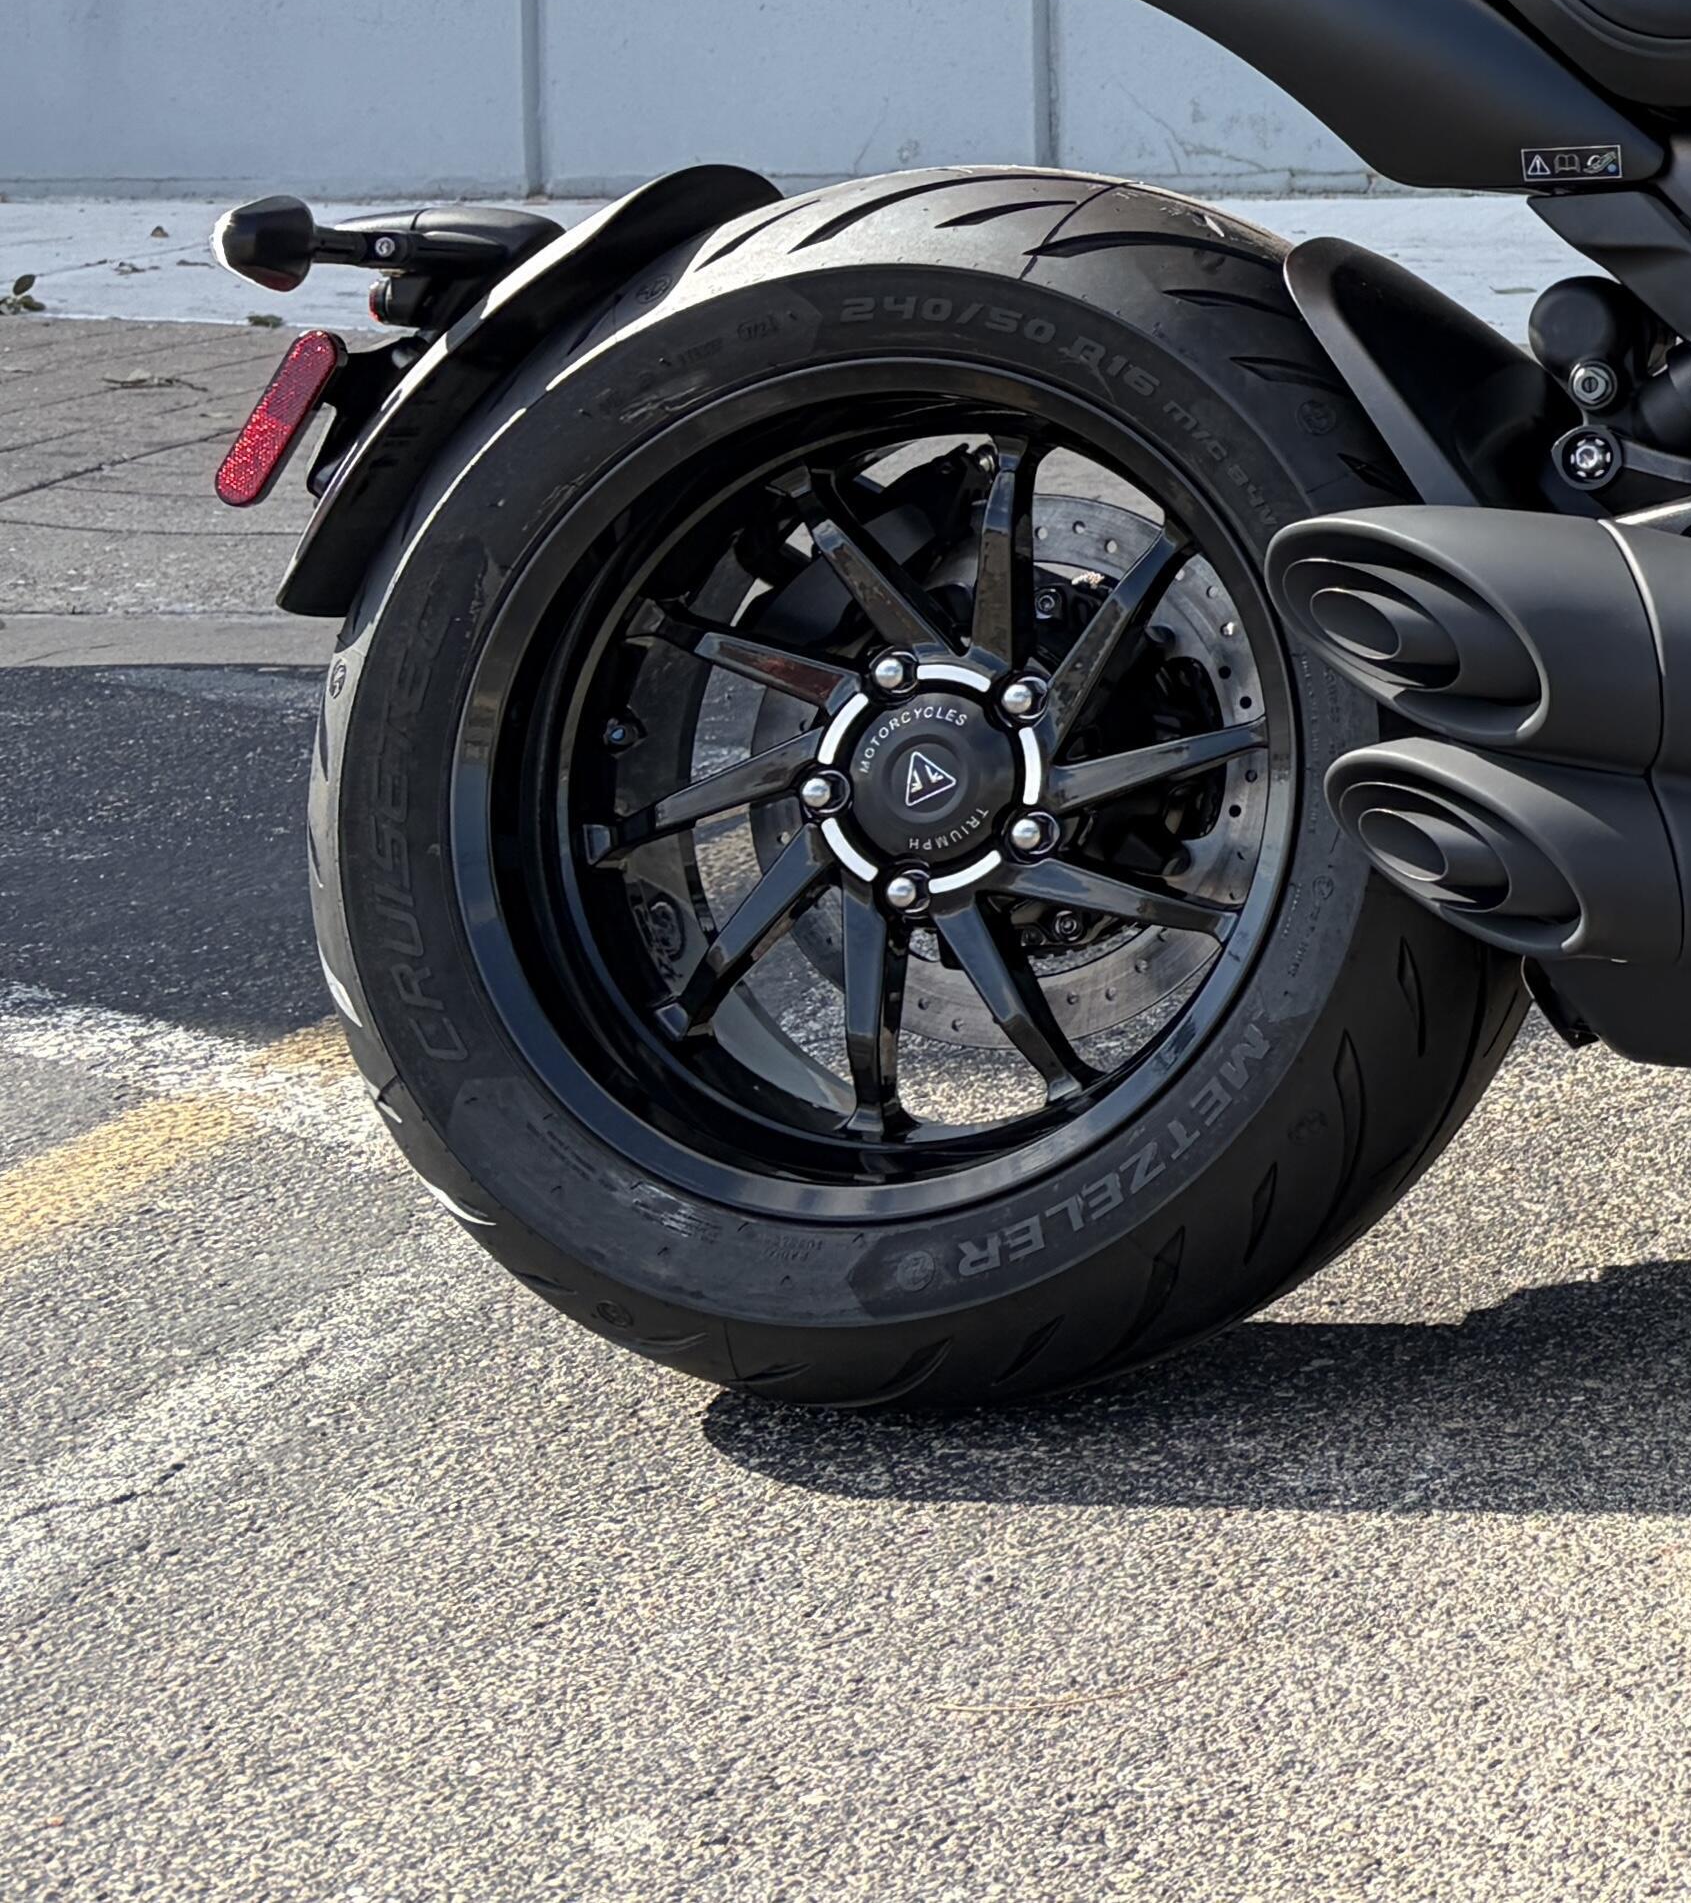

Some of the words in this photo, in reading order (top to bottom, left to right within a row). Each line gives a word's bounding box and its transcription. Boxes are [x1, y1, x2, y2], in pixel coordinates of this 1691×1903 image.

[838, 295, 1058, 348] 240/50
[859, 706, 968, 774] MOTORCYCLES
[908, 806, 990, 851] TRIUMPH
[957, 1023, 1272, 1278] METZELER
